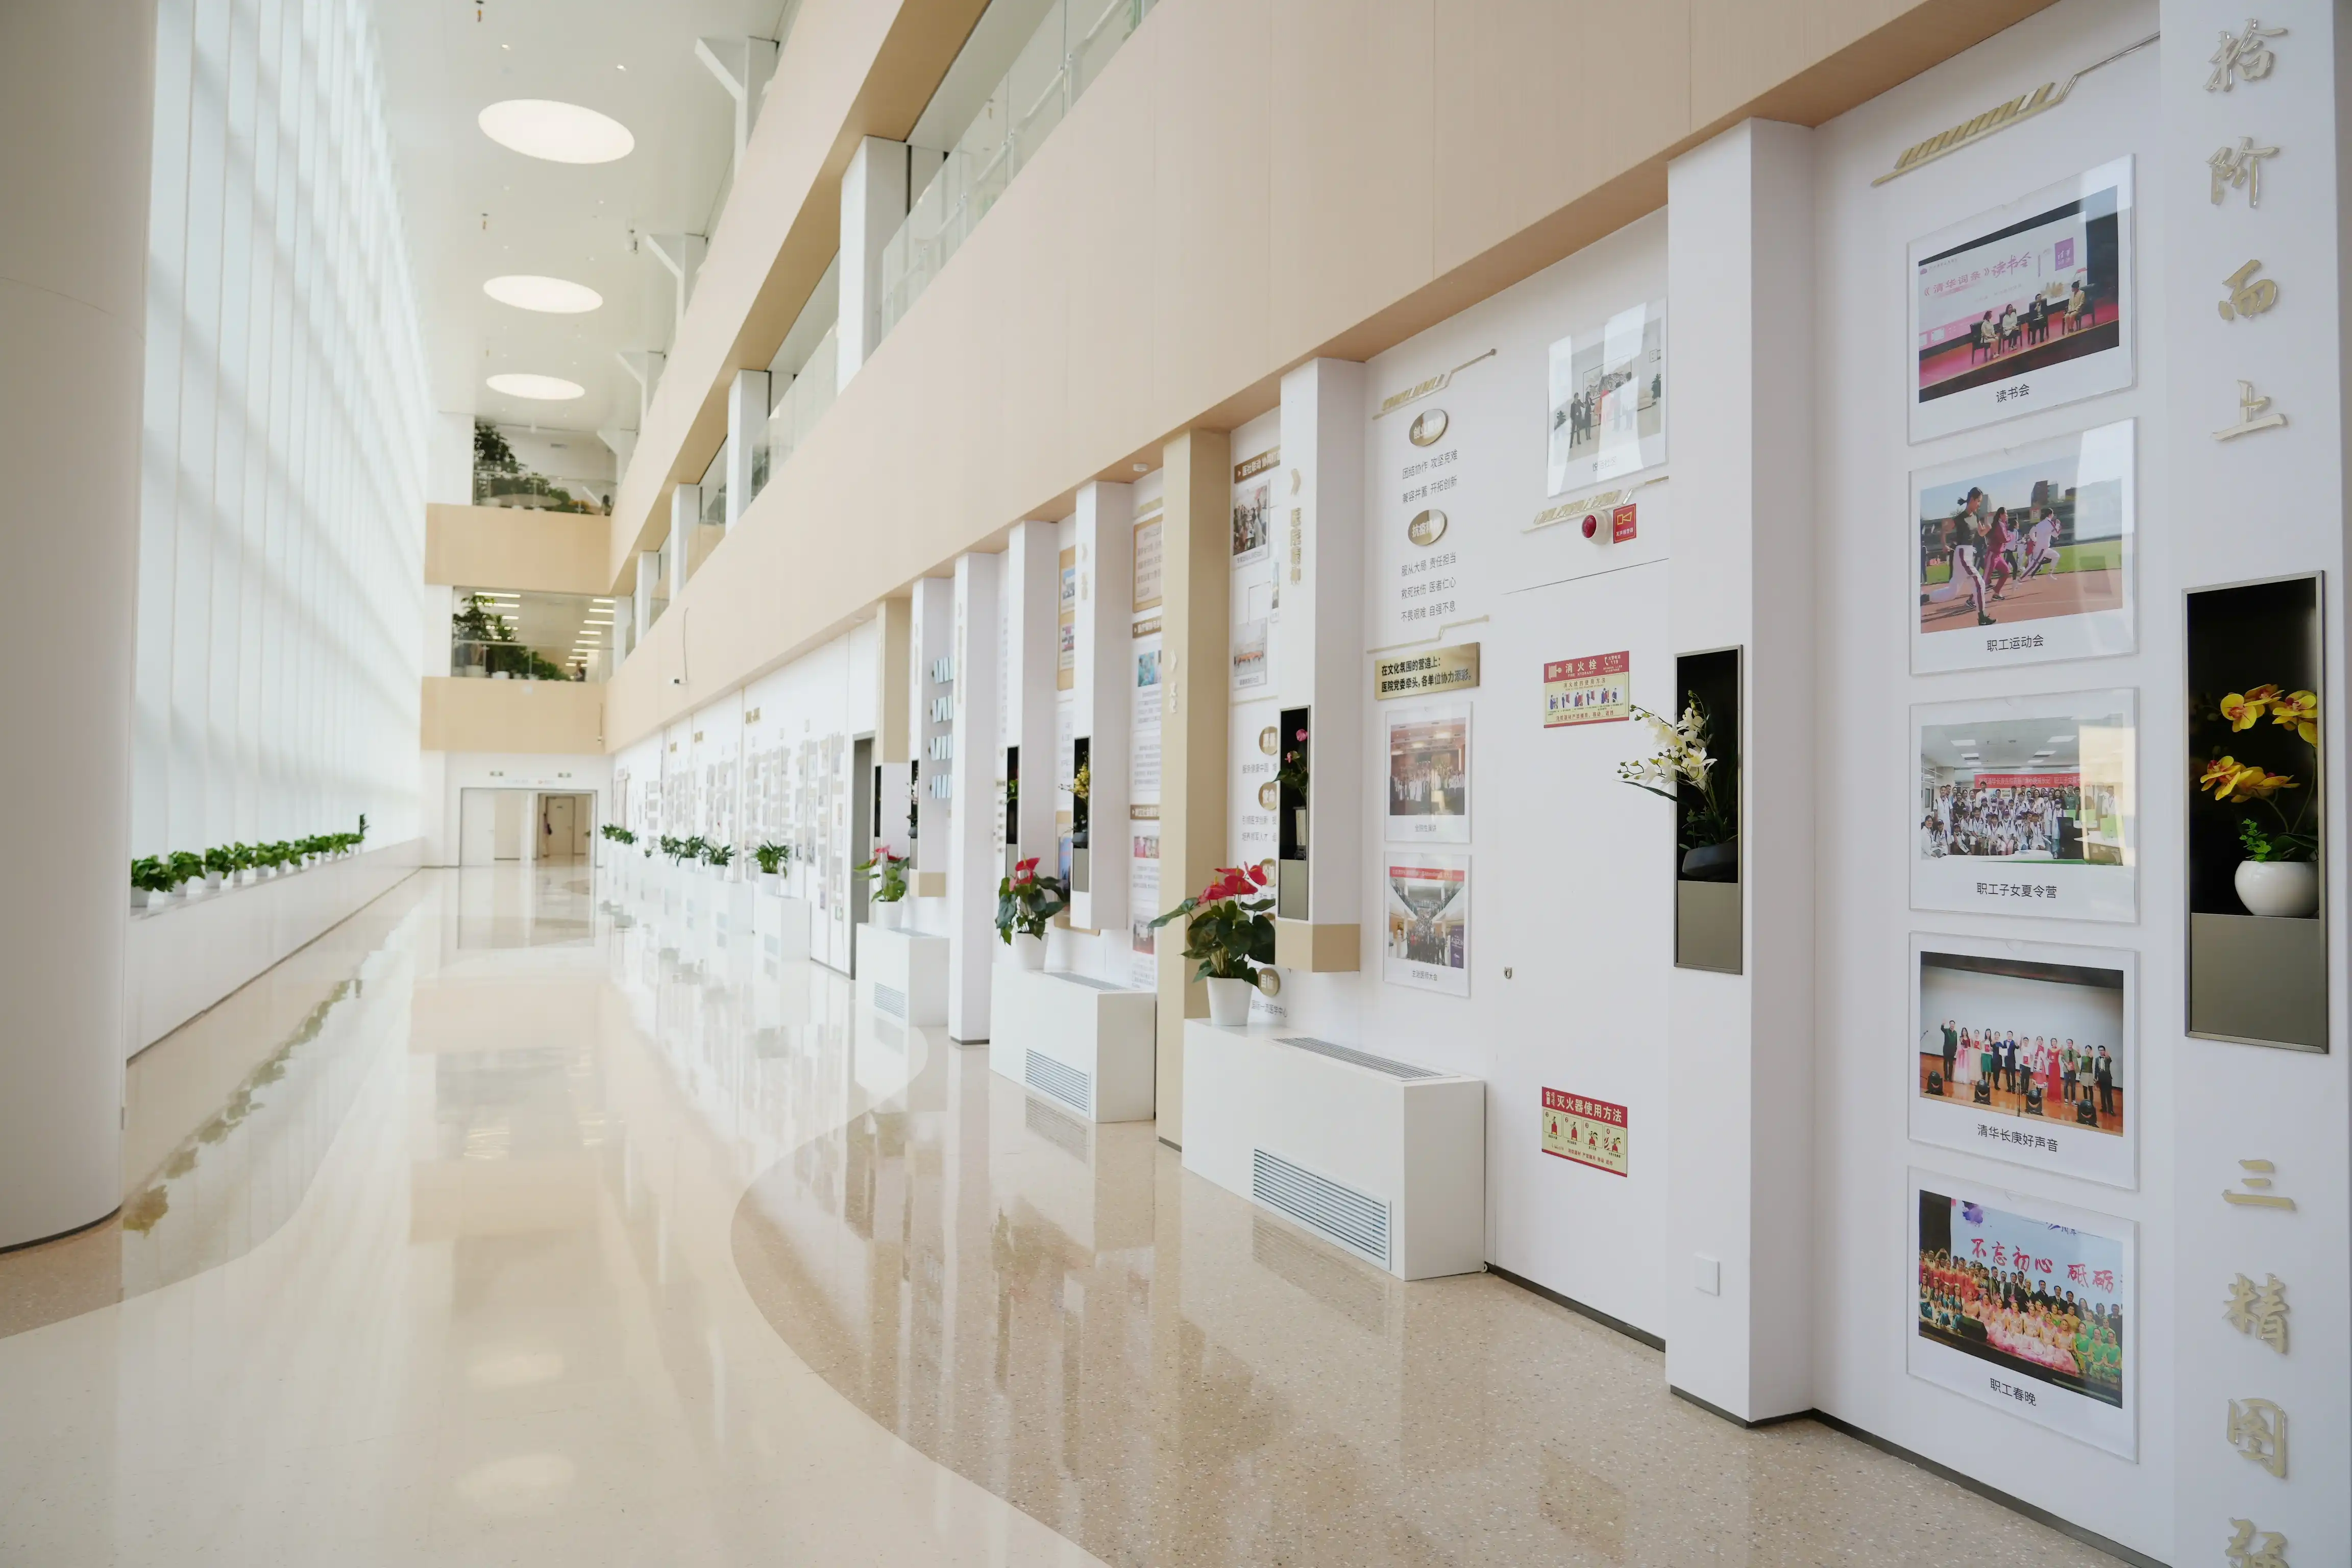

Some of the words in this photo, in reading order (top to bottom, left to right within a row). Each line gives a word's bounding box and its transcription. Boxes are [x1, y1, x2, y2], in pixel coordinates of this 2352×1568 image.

[2203, 18, 2288, 442] 拾阶而上
[1996, 383, 2030, 404] 读书会
[1403, 461, 1428, 479] 团结协作
[1431, 449, 1458, 469] 攻坚克难
[1402, 485, 1428, 504] 兼容并蓄
[1430, 475, 1457, 494] 开拓创新
[1402, 560, 1427, 577] 服从大局
[1430, 552, 1456, 569] 责任担当
[1401, 584, 1426, 600] 救死扶伤
[1430, 577, 1456, 593] 医者仁心
[1401, 607, 1426, 622] 不畏艰难
[1430, 601, 1456, 617] 自强不息
[1987, 634, 2044, 652] 职工运动会
[1565, 659, 1597, 673] 消火栓
[1564, 678, 1605, 688] 消火栓的使用方法
[1976, 882, 2057, 899] 职工子女夏令营
[1557, 1095, 1622, 1123] 灭火器使用方法
[1977, 1123, 2059, 1153] 清华长庚好声音
[1971, 1238, 2053, 1273] 不忘初心
[1990, 1378, 2037, 1407] 职工春晚
